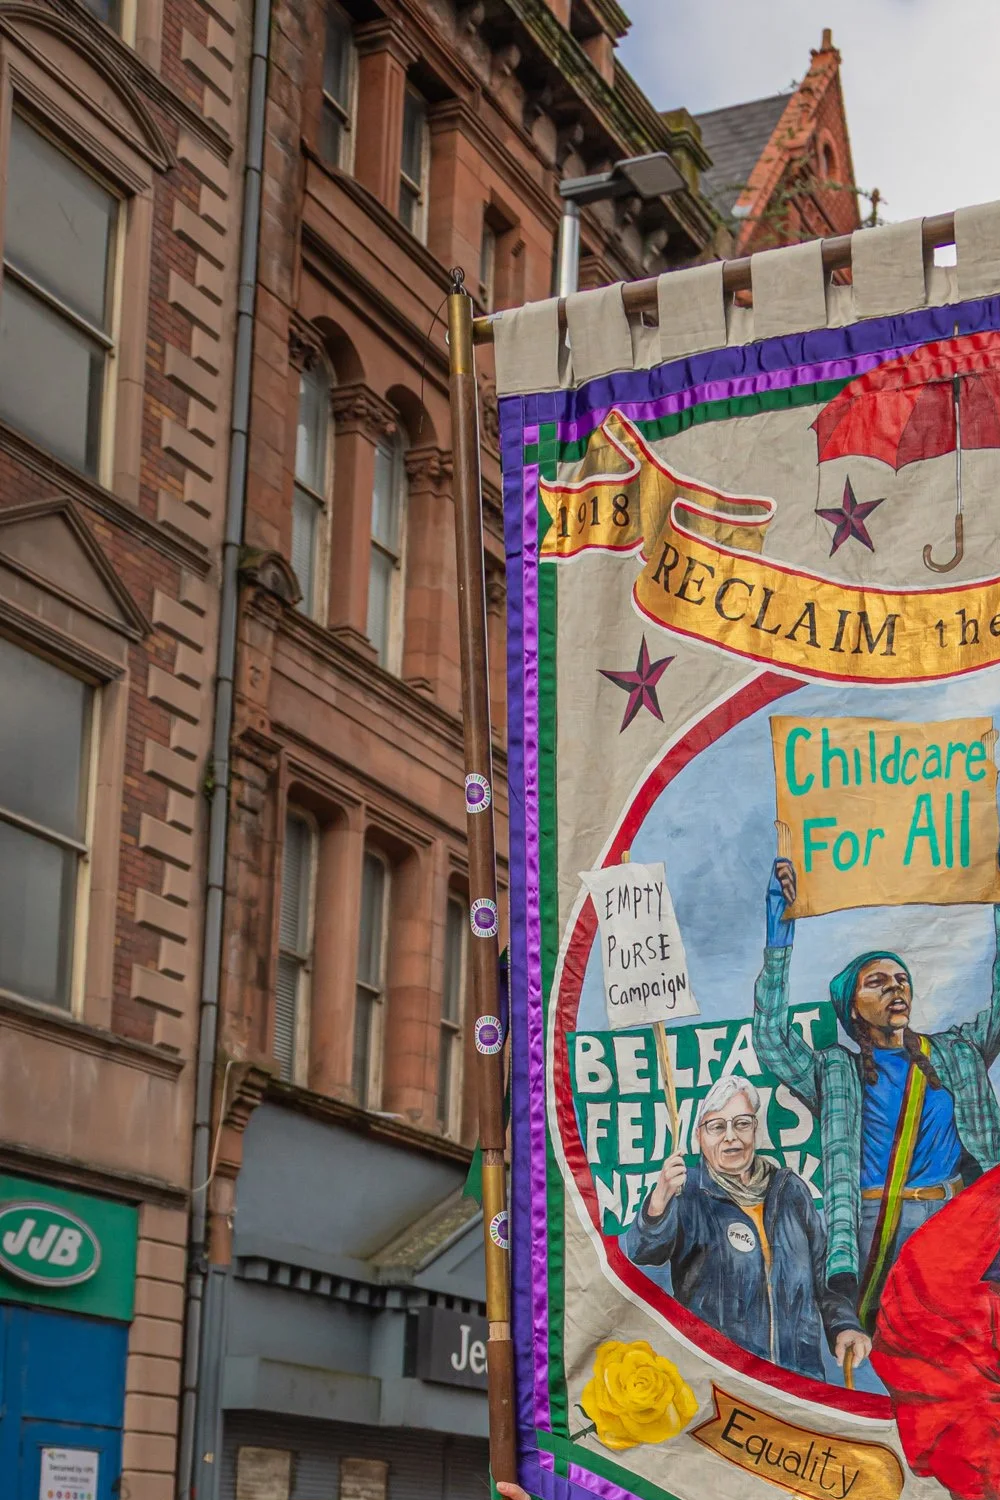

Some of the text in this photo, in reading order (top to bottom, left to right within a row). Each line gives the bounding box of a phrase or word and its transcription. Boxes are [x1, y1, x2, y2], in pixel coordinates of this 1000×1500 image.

[558, 493, 630, 537] 1918
[651, 541, 900, 658] RECLAIM
[785, 727, 987, 796] Childcare
[803, 790, 970, 873] For All
[607, 933, 670, 969] PURSE
[575, 1008, 821, 1095] BELFAT
[3, 1218, 83, 1267] JJB
[451, 1324, 488, 1375] Je
[720, 1408, 860, 1500] Equality
